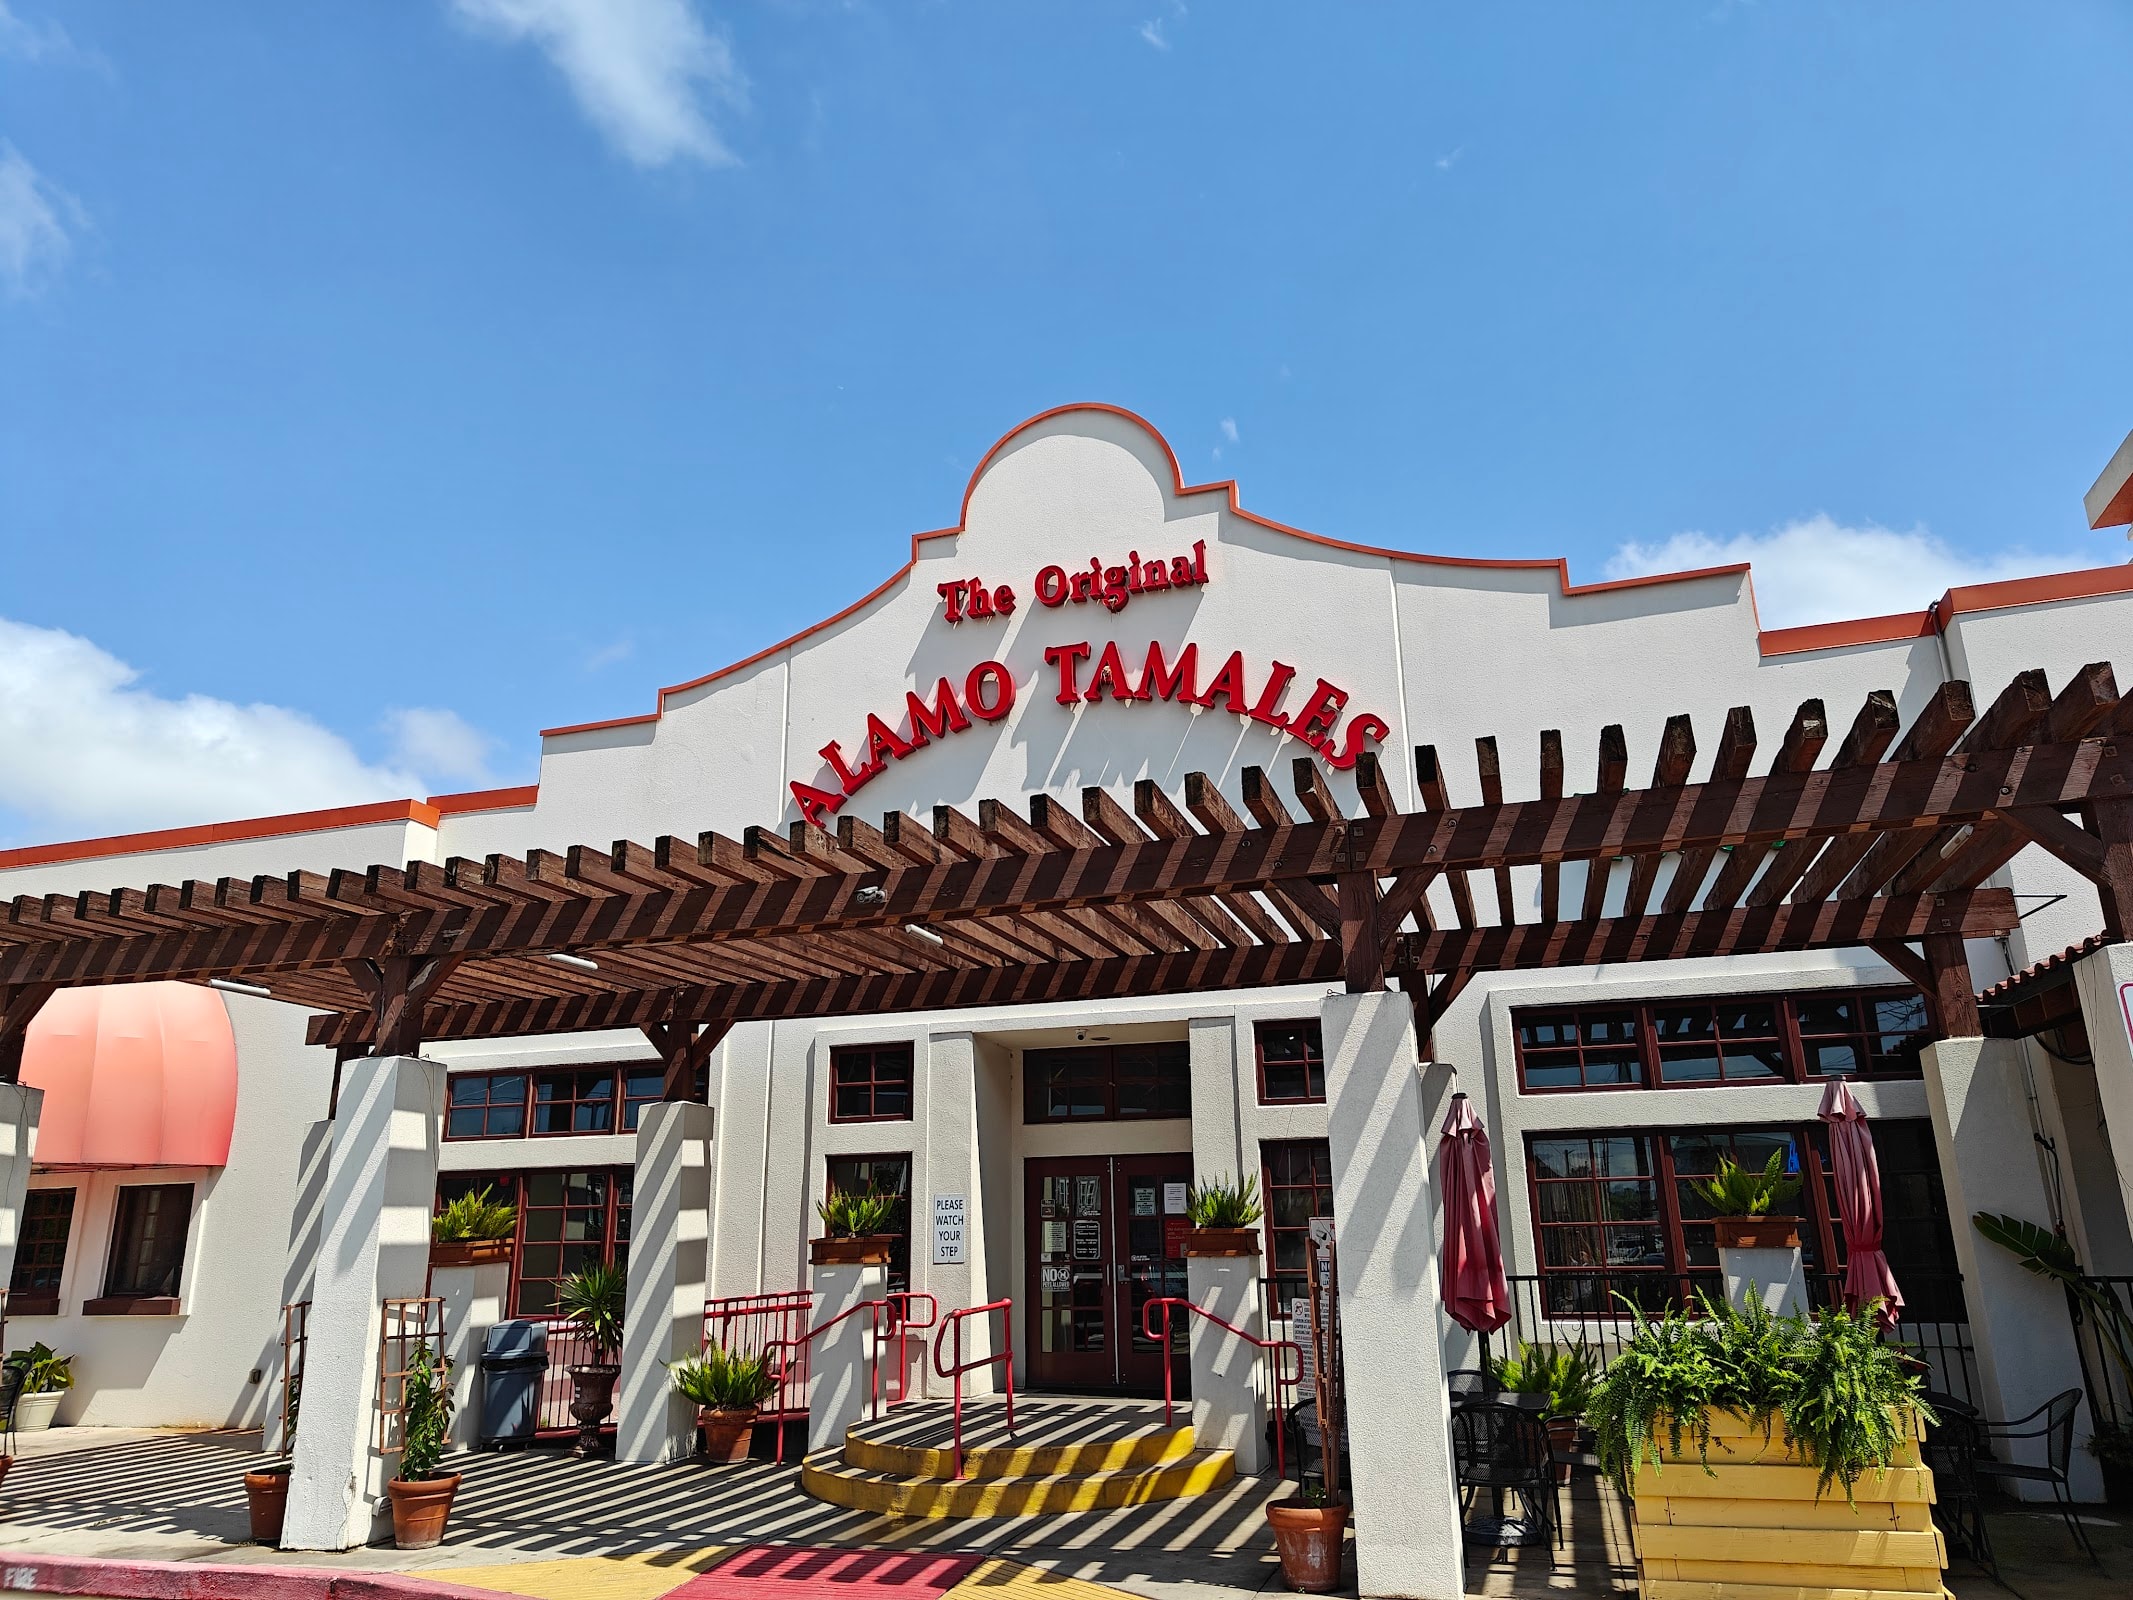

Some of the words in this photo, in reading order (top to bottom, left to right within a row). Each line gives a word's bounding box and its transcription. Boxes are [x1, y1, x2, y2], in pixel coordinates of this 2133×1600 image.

[937, 576, 1016, 623] The
[1034, 538, 1209, 613] Original
[789, 660, 1016, 829] ALAMO
[1044, 640, 1390, 770] TAMALES
[936, 1199, 963, 1210] PLEASE
[935, 1215, 964, 1226] WATCH
[938, 1230, 961, 1241] YOUR
[940, 1246, 959, 1257] STEP
[1042, 1268, 1058, 1282] NO
